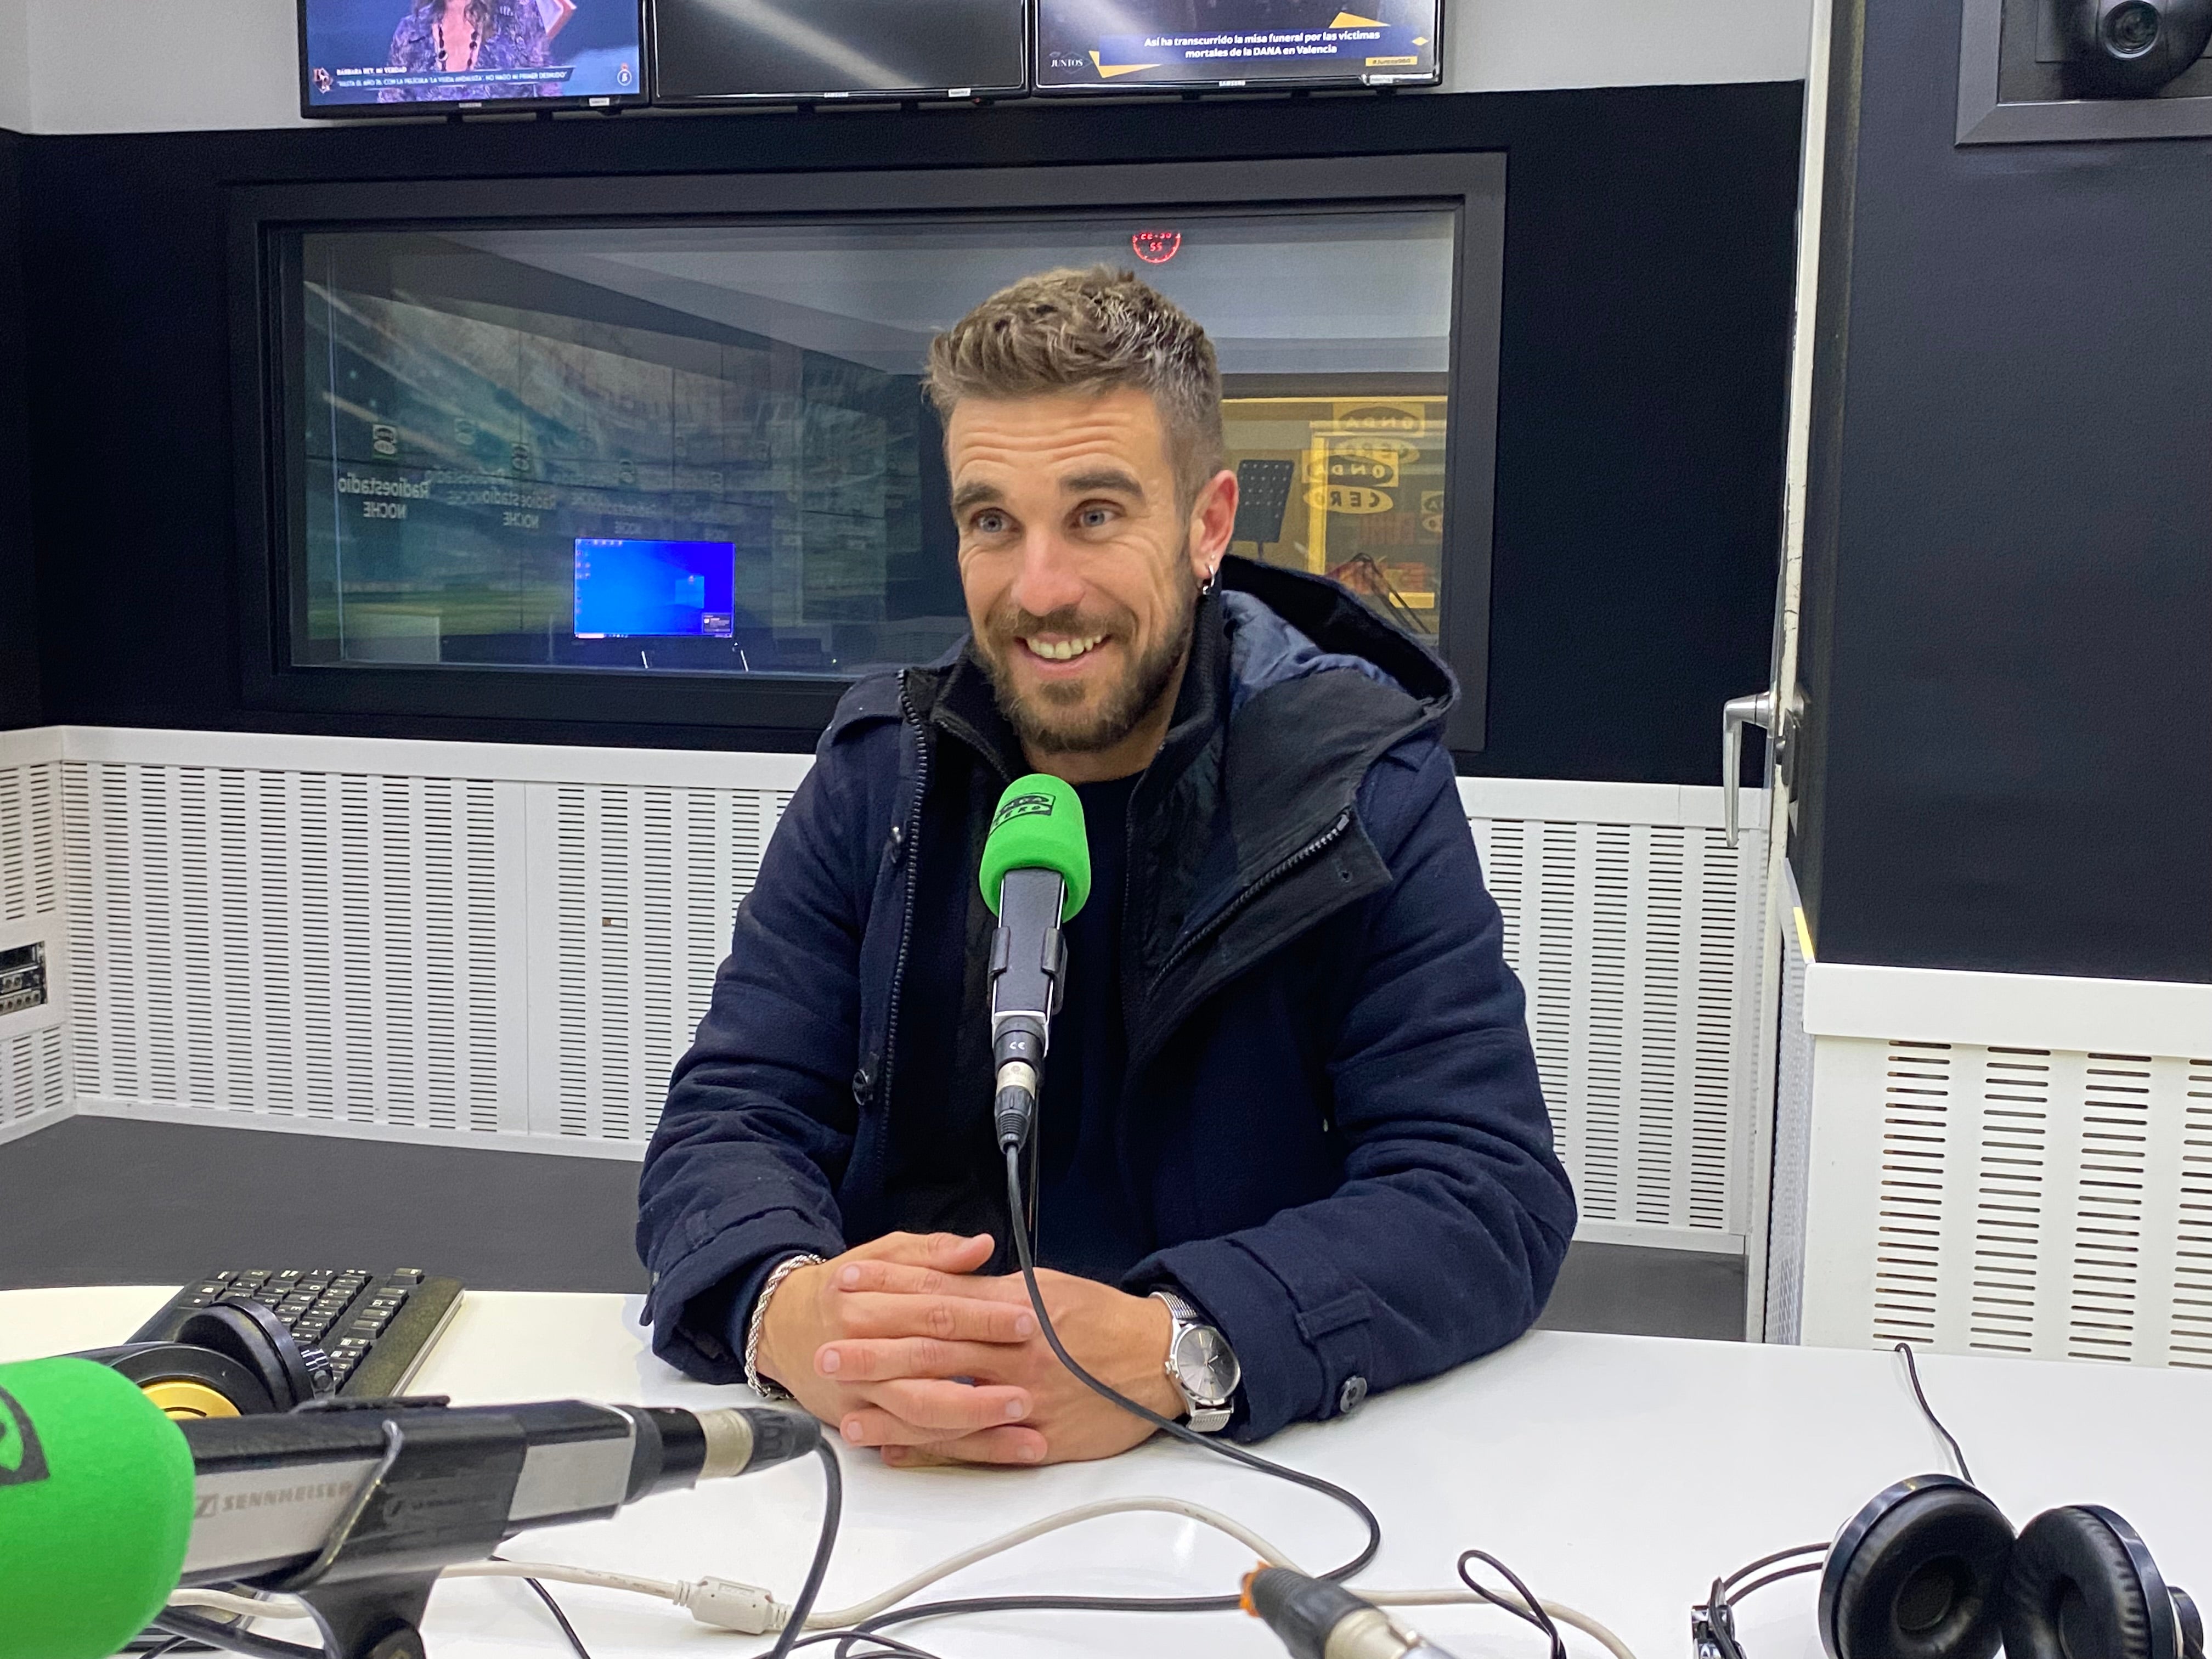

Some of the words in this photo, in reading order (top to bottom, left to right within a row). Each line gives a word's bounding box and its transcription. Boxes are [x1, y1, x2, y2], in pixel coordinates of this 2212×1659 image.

[1144, 36, 1159, 47] Así
[1161, 37, 1172, 46] ha
[1174, 35, 1233, 46] transcurrido
[1234, 35, 1243, 44] la
[1244, 33, 1267, 43] misa
[1269, 32, 1303, 42] funeral
[1305, 33, 1322, 43] por
[1323, 31, 1337, 41] las
[1339, 30, 1380, 40] víctimas
[1185, 48, 1228, 58] mortales
[1229, 48, 1242, 57] de
[1243, 47, 1252, 56] la
[1253, 46, 1281, 55] DANA
[1283, 46, 1295, 54] en
[1296, 44, 1337, 54] Valencia
[1051, 59, 1083, 67] JUNTOS
[222, 1481, 353, 1511] SENNHEISER
